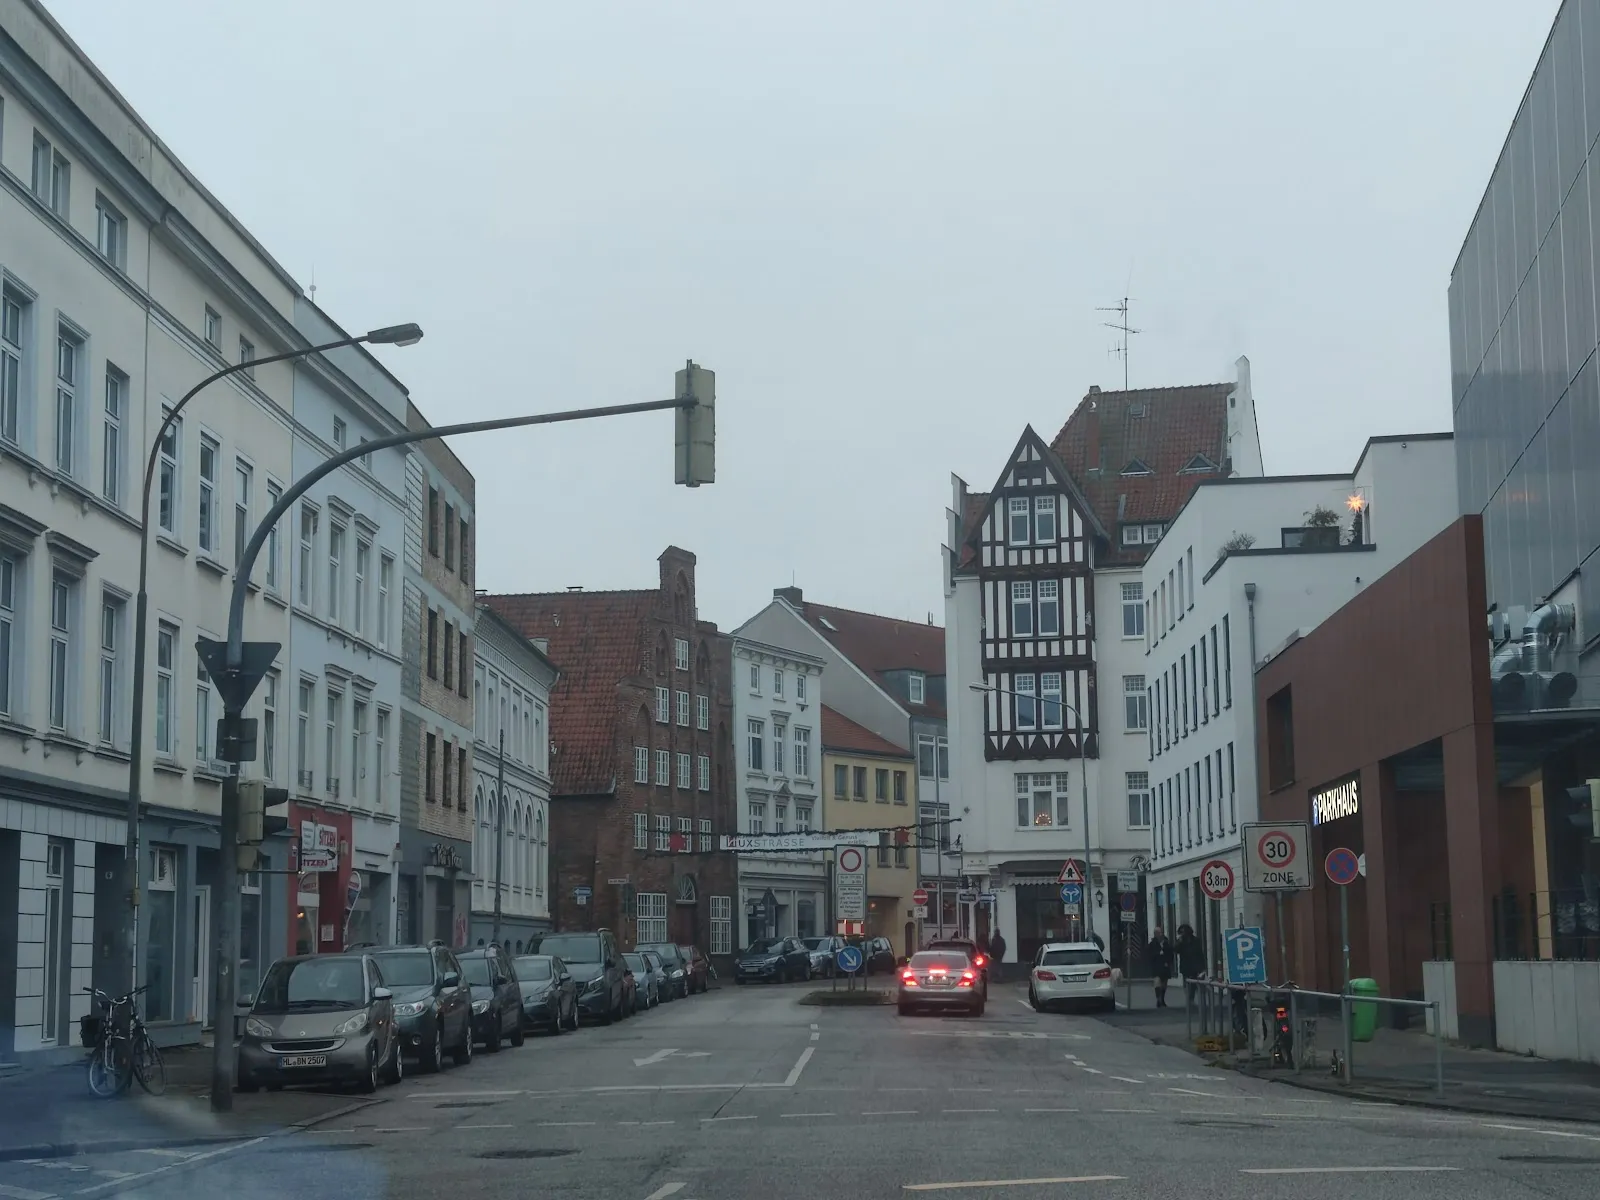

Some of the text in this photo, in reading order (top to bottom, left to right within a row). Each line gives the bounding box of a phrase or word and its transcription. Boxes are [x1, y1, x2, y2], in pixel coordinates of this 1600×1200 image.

[1318, 780, 1358, 825] PARKHAUS
[1266, 841, 1287, 858] 30
[302, 859, 328, 867] ITZEN
[1207, 872, 1228, 888] 3,8m
[1263, 872, 1294, 884] ZONE
[1236, 937, 1253, 960] P
